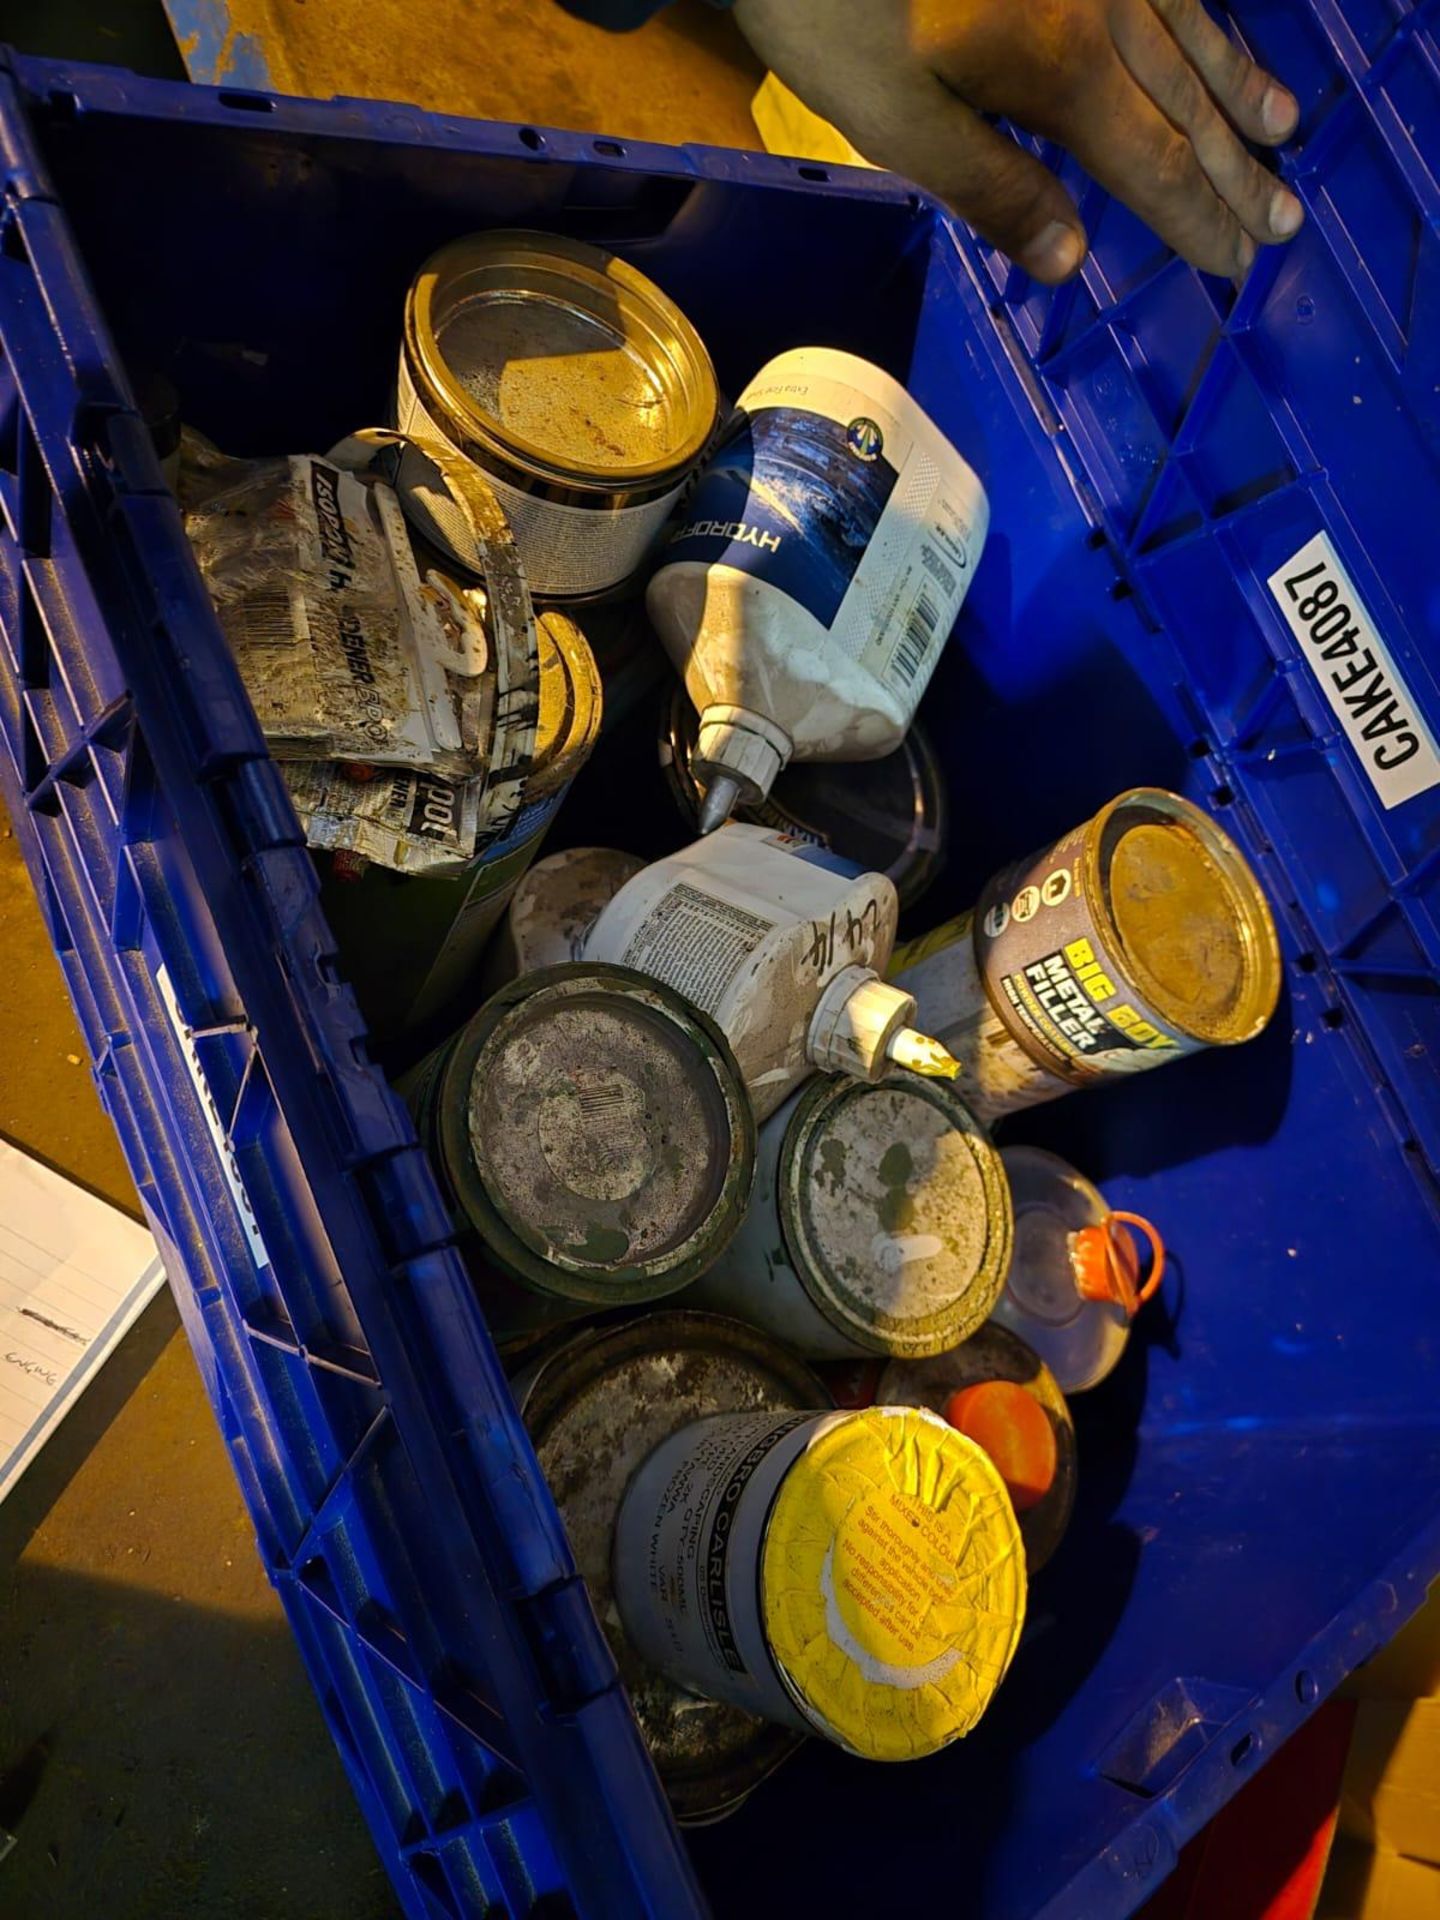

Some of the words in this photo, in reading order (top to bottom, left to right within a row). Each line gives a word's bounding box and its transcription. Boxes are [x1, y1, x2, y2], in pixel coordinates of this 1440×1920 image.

[329, 568, 375, 684] HDENER
[1284, 561, 1420, 770] CAKE4087
[1002, 977, 1019, 1006] HIGH
[1014, 973, 1041, 1018] POWDER
[1025, 963, 1097, 1050] FILLER
[1044, 954, 1107, 1035] METAL
[1064, 937, 1117, 1002] BIG
[1106, 1003, 1180, 1050] BOY
[709, 1511, 744, 1670] CARLISLE
[842, 1538, 857, 1556] No
